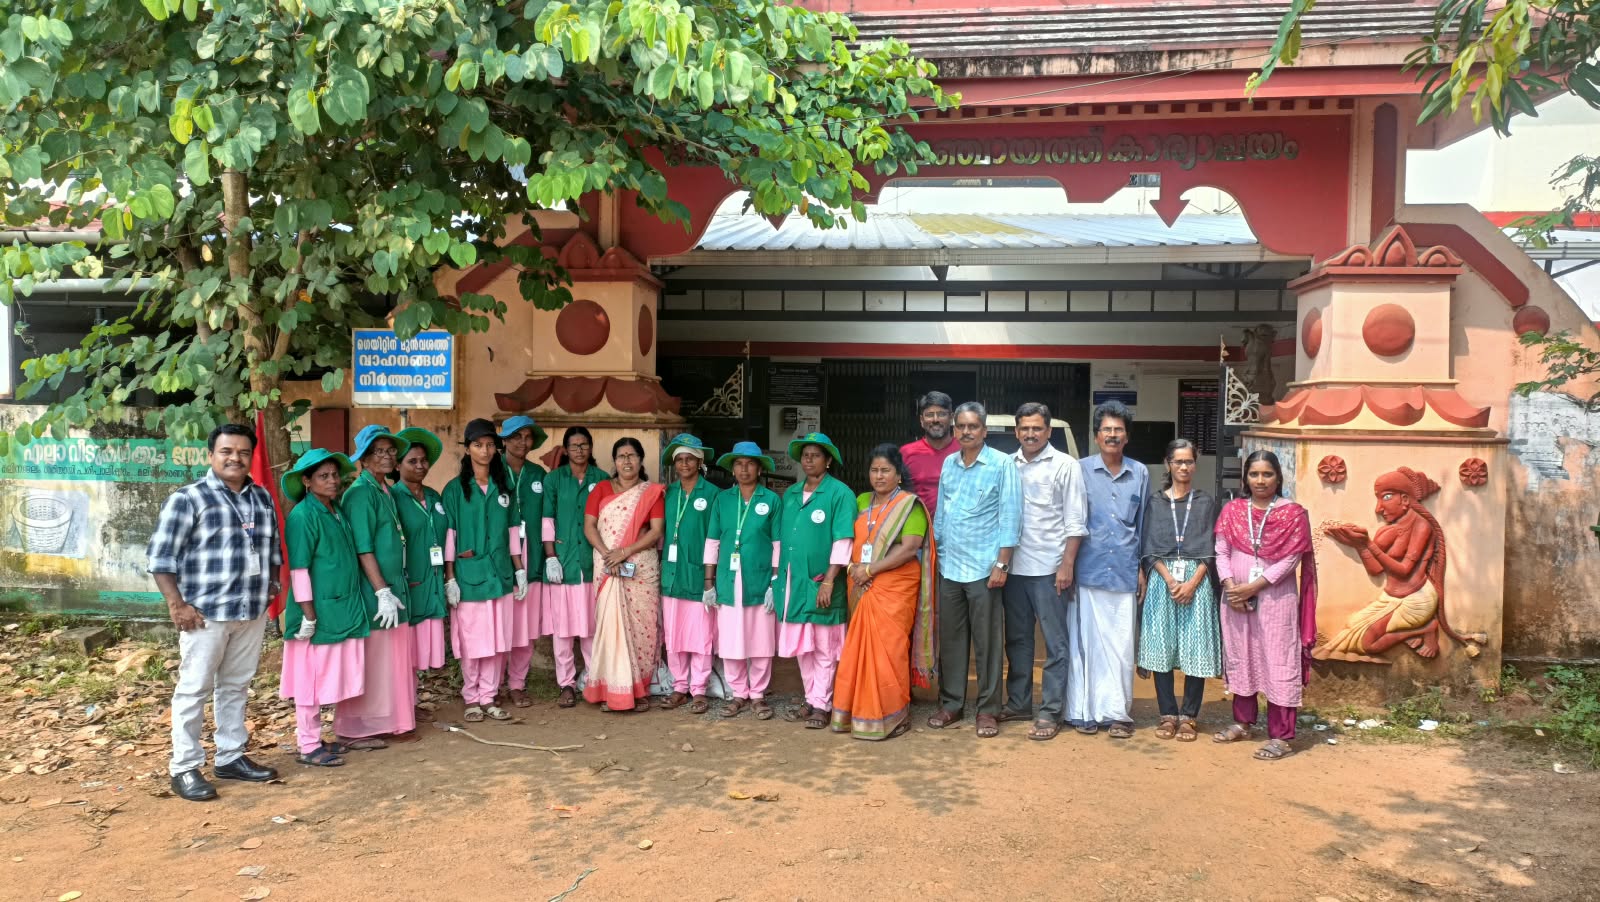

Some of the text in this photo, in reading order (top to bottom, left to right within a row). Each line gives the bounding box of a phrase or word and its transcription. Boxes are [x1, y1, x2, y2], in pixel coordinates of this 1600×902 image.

[1107, 130, 1299, 170] കാര്യാലയം
[359, 353, 446, 366] വാഹനങ്ങൾ
[359, 371, 448, 389] നിർത്തരുത്
[24, 444, 66, 465] എല്ലാ
